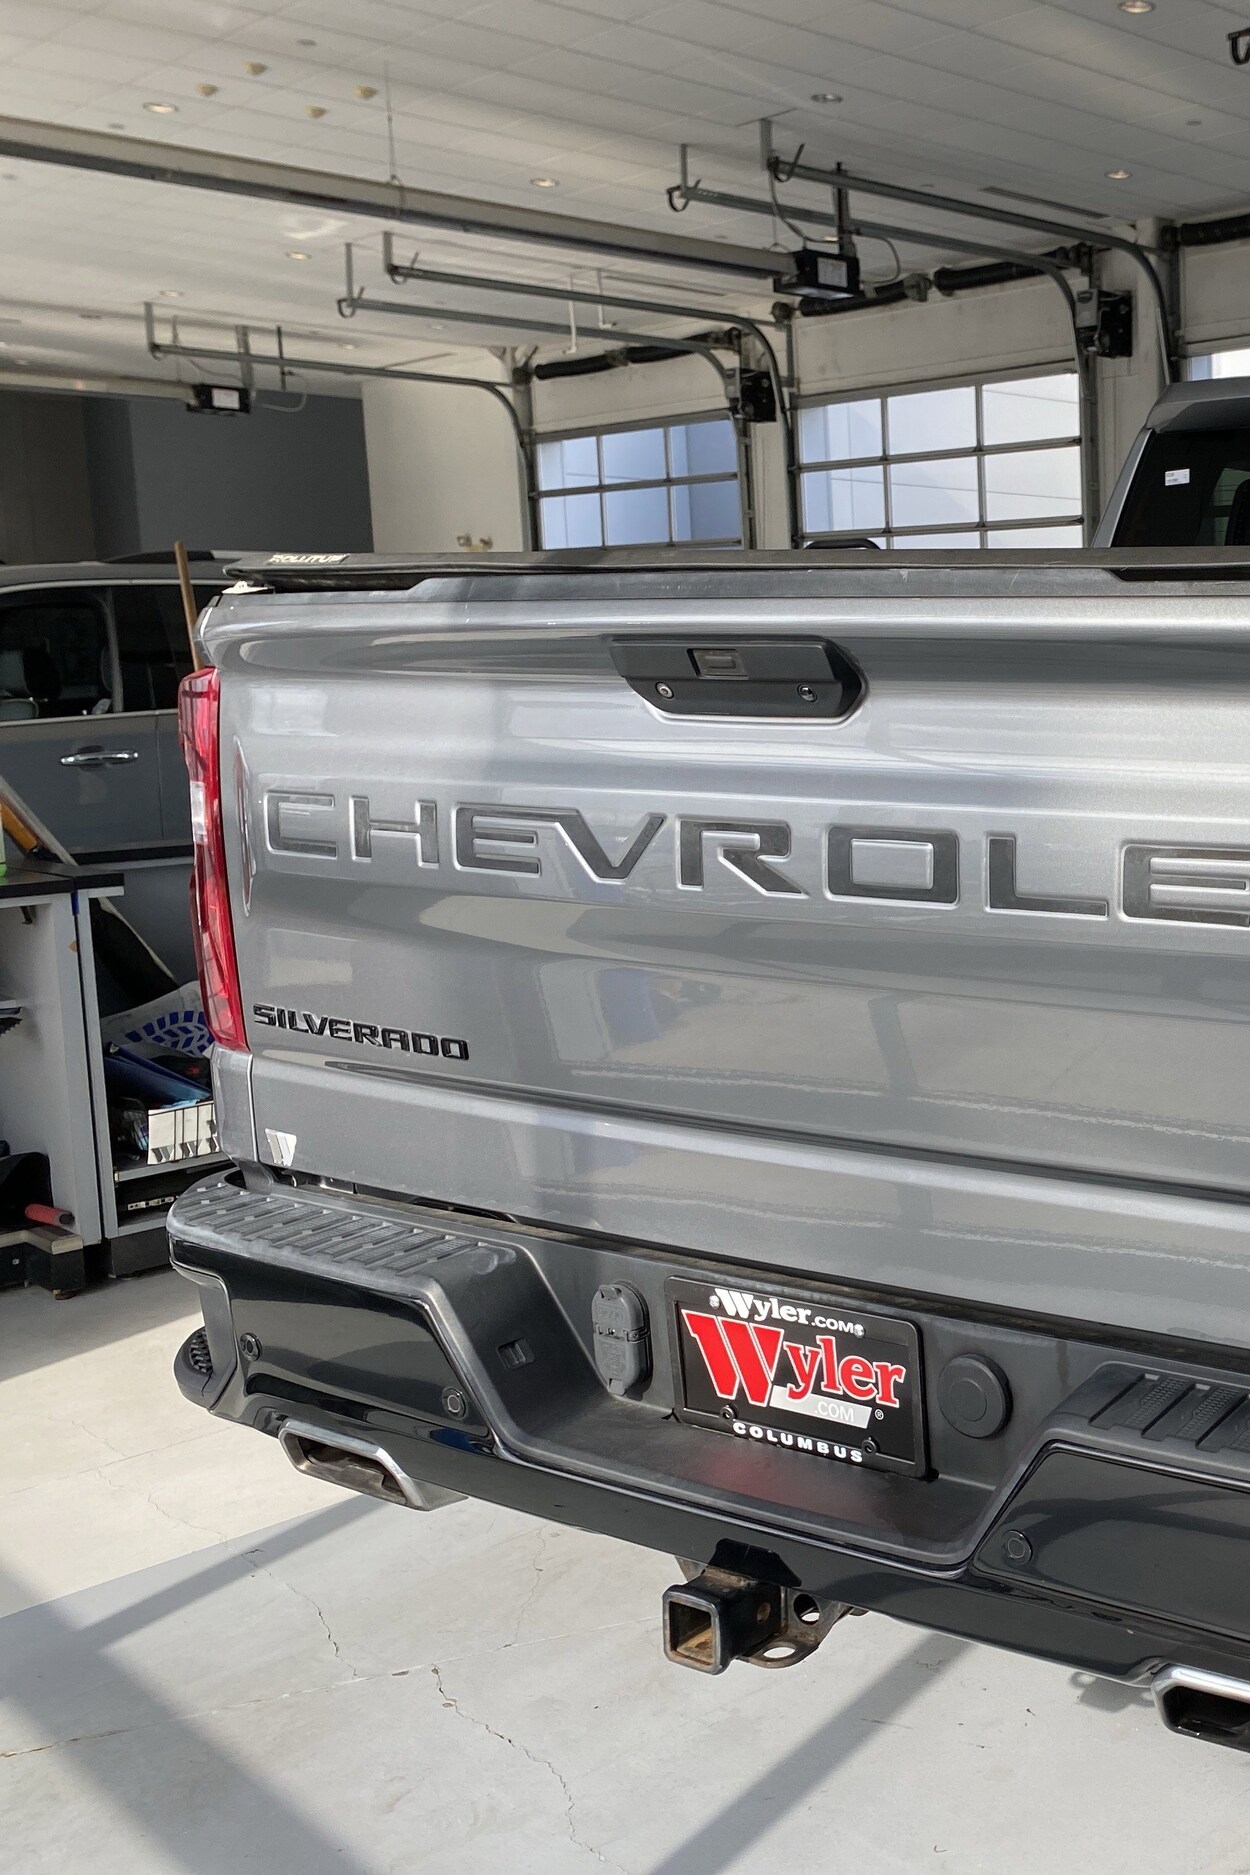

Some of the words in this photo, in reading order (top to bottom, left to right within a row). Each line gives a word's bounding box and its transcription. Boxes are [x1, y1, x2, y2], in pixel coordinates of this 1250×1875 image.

[252, 1003, 470, 1061] SILVERADO
[681, 1309, 906, 1408] Wyler
[732, 1421, 863, 1463] COLUMBUS
